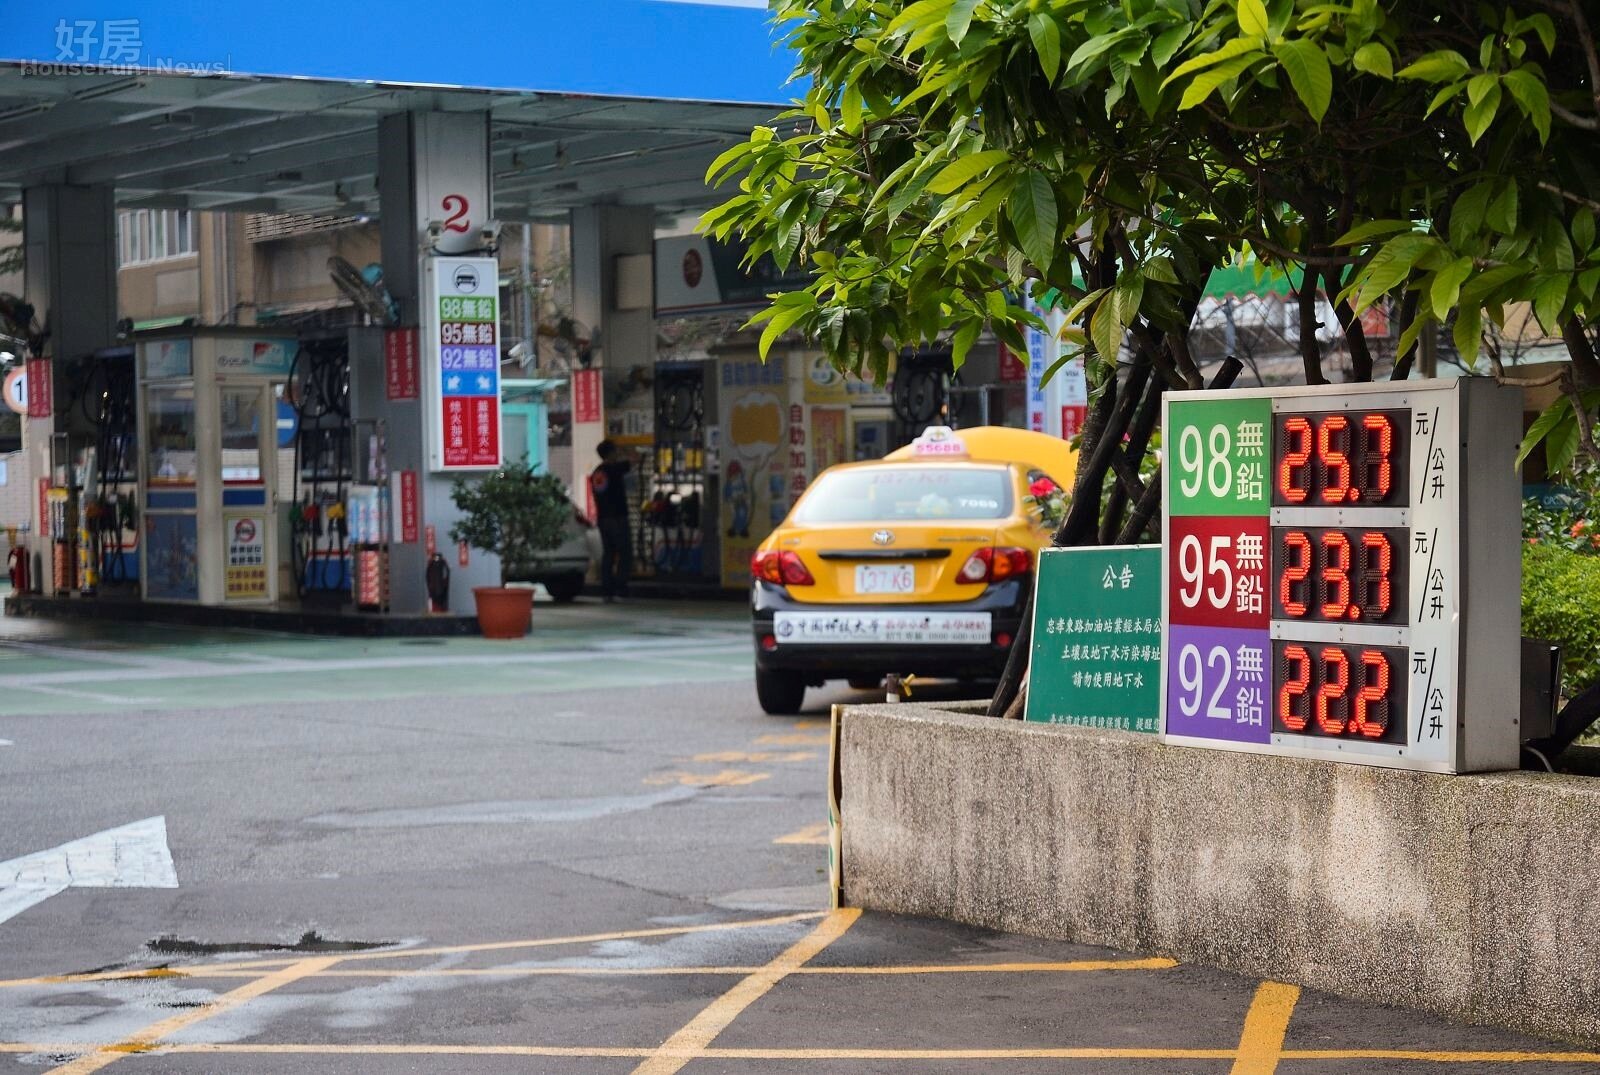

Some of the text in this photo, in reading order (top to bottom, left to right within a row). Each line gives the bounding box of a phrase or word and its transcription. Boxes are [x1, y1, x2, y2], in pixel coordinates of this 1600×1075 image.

[442, 194, 470, 233] 2
[441, 299, 493, 319] 98無鉛
[441, 323, 493, 344] 95無鉛
[442, 348, 494, 369] 92無鉛
[790, 404, 807, 500] 自助加油
[916, 443, 961, 452] 55688
[1179, 424, 1232, 498] 98
[1236, 420, 1264, 501] 無鉛
[1279, 415, 1391, 502] 25.7
[1102, 564, 1134, 589] 公告
[1179, 534, 1233, 608] 95
[1236, 532, 1264, 613] 無鉛
[1279, 531, 1391, 620] 23.7
[1072, 672, 1144, 689] 請勿使用地下水
[1179, 644, 1232, 719] 92
[1236, 645, 1264, 726] 無鉛
[1279, 645, 1389, 738] 22.2
